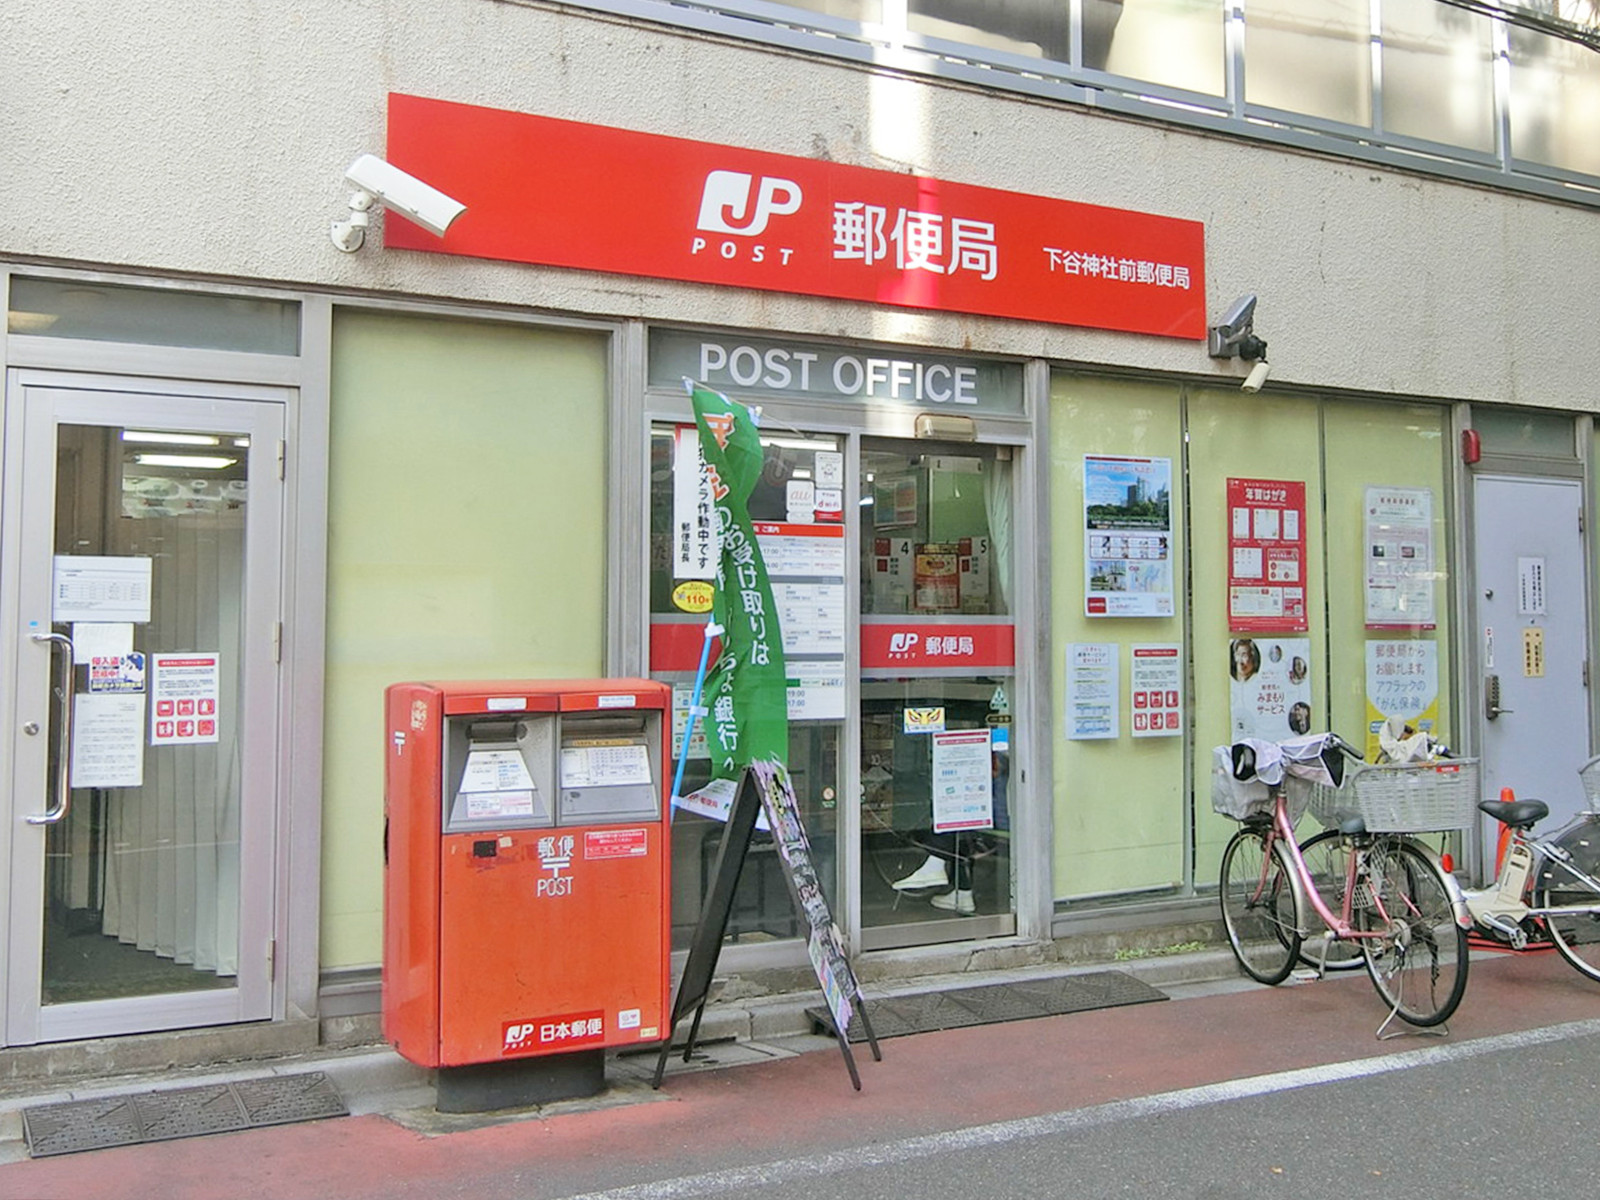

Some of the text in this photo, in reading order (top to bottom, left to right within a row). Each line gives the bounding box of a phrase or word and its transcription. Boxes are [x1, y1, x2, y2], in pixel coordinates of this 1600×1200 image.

[697, 170, 803, 237] JP
[692, 236, 794, 266] POST
[833, 201, 998, 281] 郵便局
[1043, 247, 1190, 290] 下谷神社前郵便局
[700, 343, 978, 405] POST OFFICE
[697, 441, 713, 569] カメラ作動中です
[901, 541, 910, 554] 4
[925, 636, 974, 656] 郵便局
[537, 835, 574, 858] 郵便
[537, 876, 574, 897] POST
[540, 1018, 603, 1042] 日本郵便
